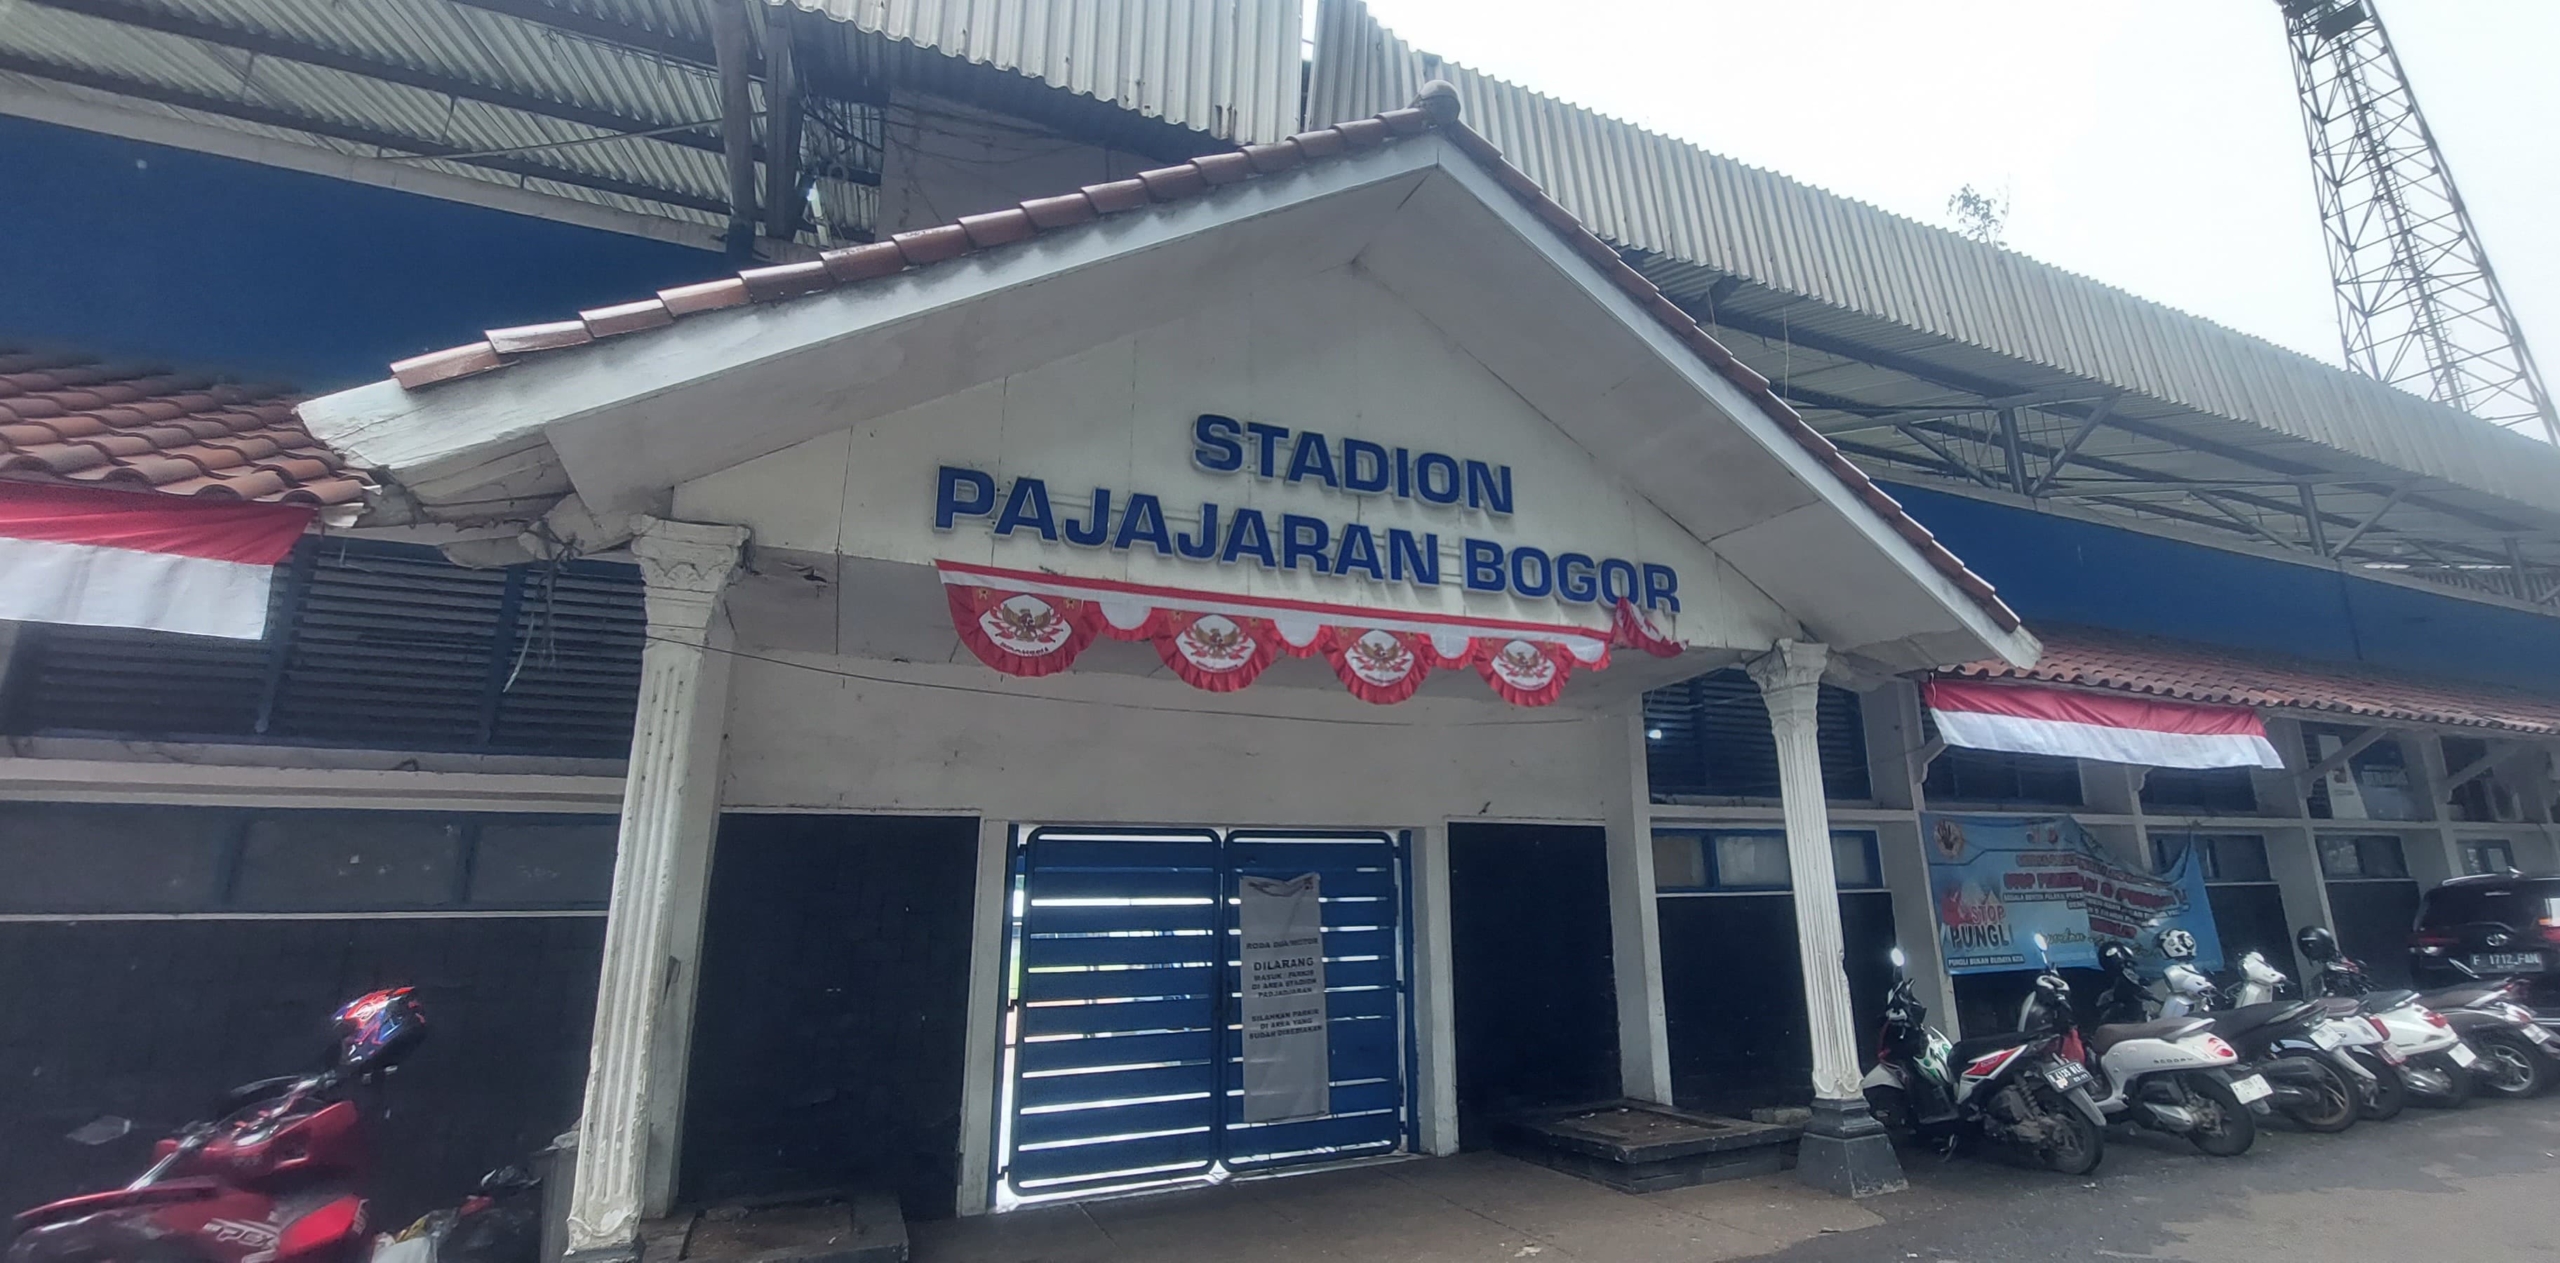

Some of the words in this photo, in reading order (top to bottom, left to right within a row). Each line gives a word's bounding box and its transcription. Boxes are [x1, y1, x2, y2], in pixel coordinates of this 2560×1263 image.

[1194, 414, 1514, 515] STADION
[934, 465, 1440, 586] PAJAJARAN
[1463, 537, 1681, 613] BOGOR
[1971, 903, 2006, 924] STOP
[1950, 923, 2014, 949] PUNGLI
[1253, 957, 1314, 971] DILARANG
[1948, 957, 1969, 967] PUNGLI
[1970, 957, 1989, 966] BUKAN
[2489, 953, 2514, 965] 1712
[1253, 972, 1282, 982] MASUK
[1263, 981, 1283, 989] AREA
[1285, 978, 1316, 988] STADION
[1251, 1012, 1291, 1022] SILAHKAN
[1292, 1008, 1320, 1018] PARKIR
[1271, 1020, 1291, 1029] AREA
[1293, 1017, 1313, 1026] YANG
[1249, 1030, 1276, 1040] SUDAH
